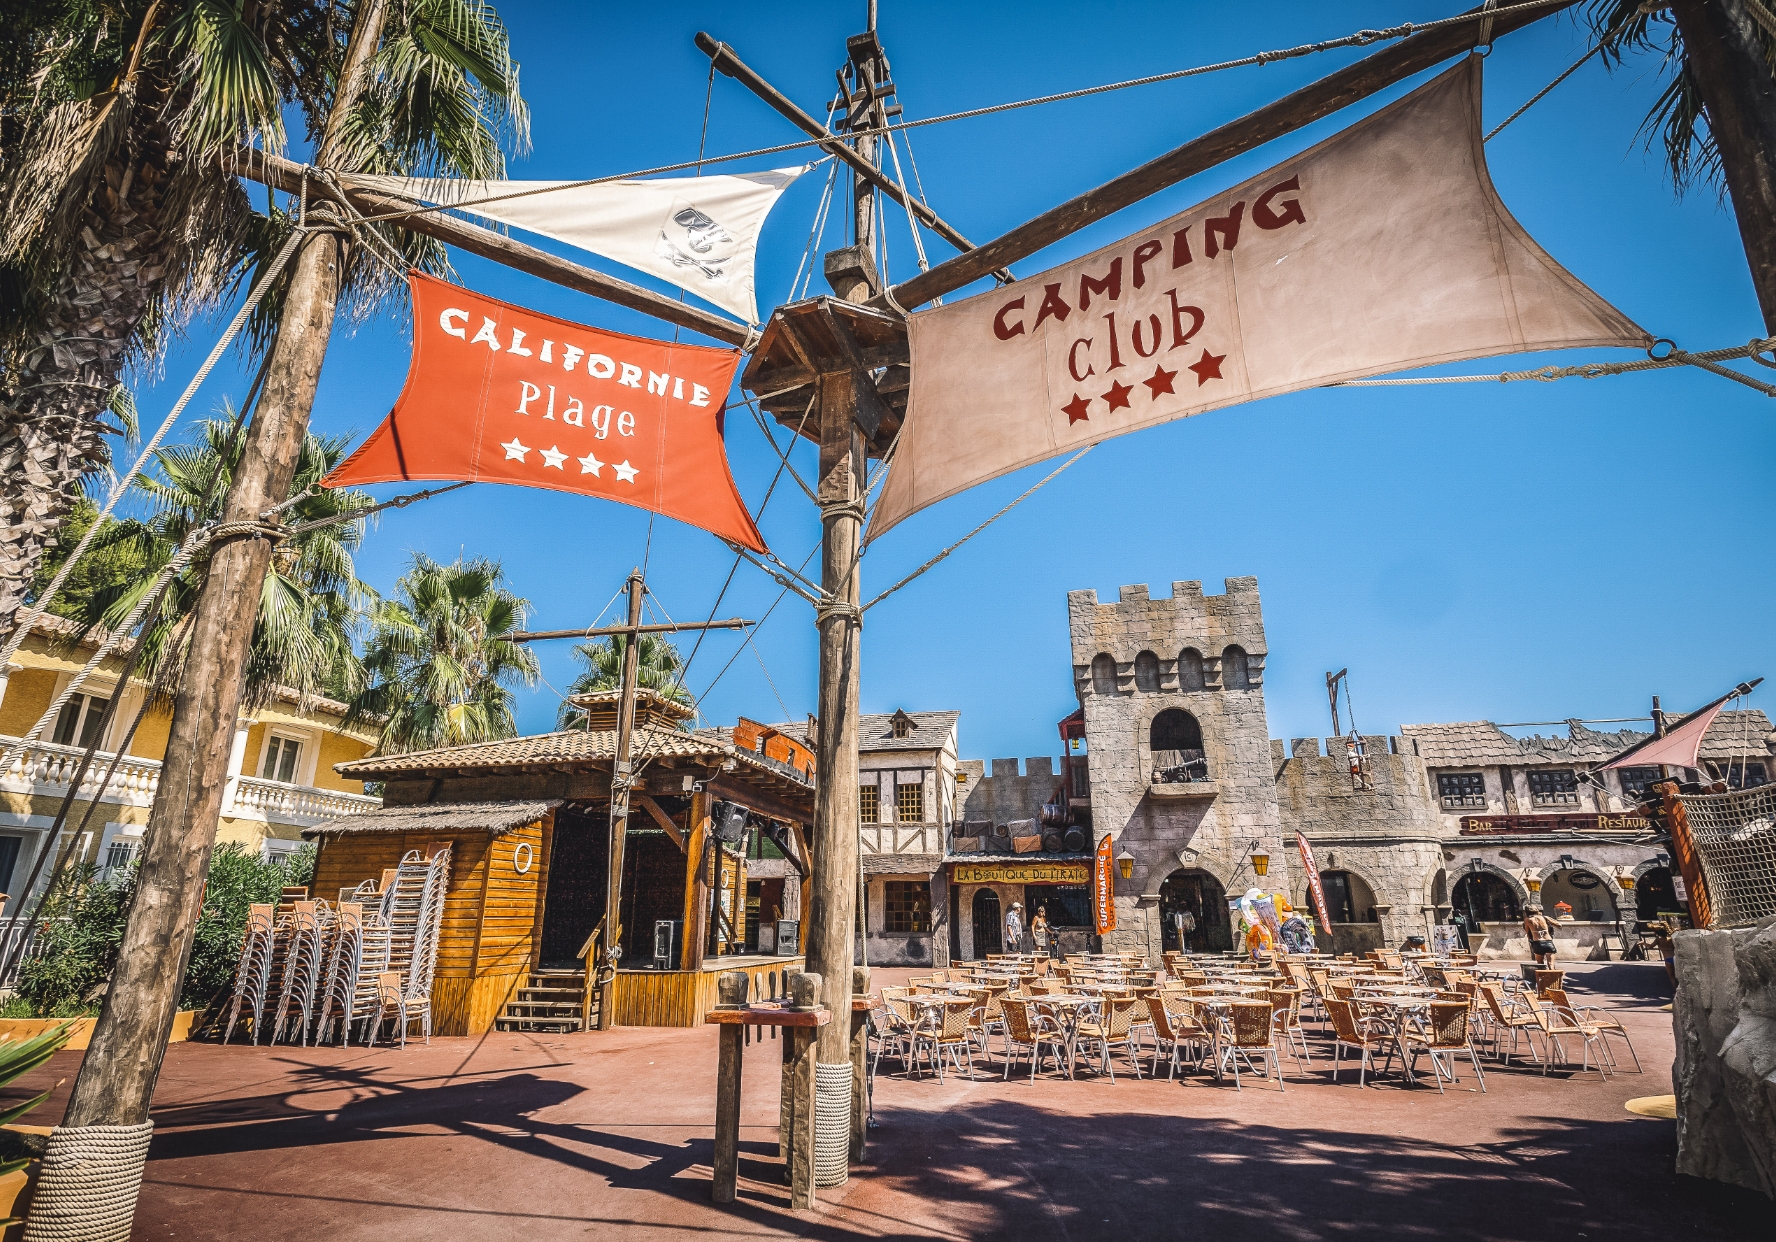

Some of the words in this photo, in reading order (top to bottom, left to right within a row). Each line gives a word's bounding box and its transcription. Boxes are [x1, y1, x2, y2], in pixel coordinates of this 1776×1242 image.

[993, 174, 1307, 341] CAMPING
[439, 307, 712, 408] CALIFORNIE
[514, 380, 636, 440] Plage
